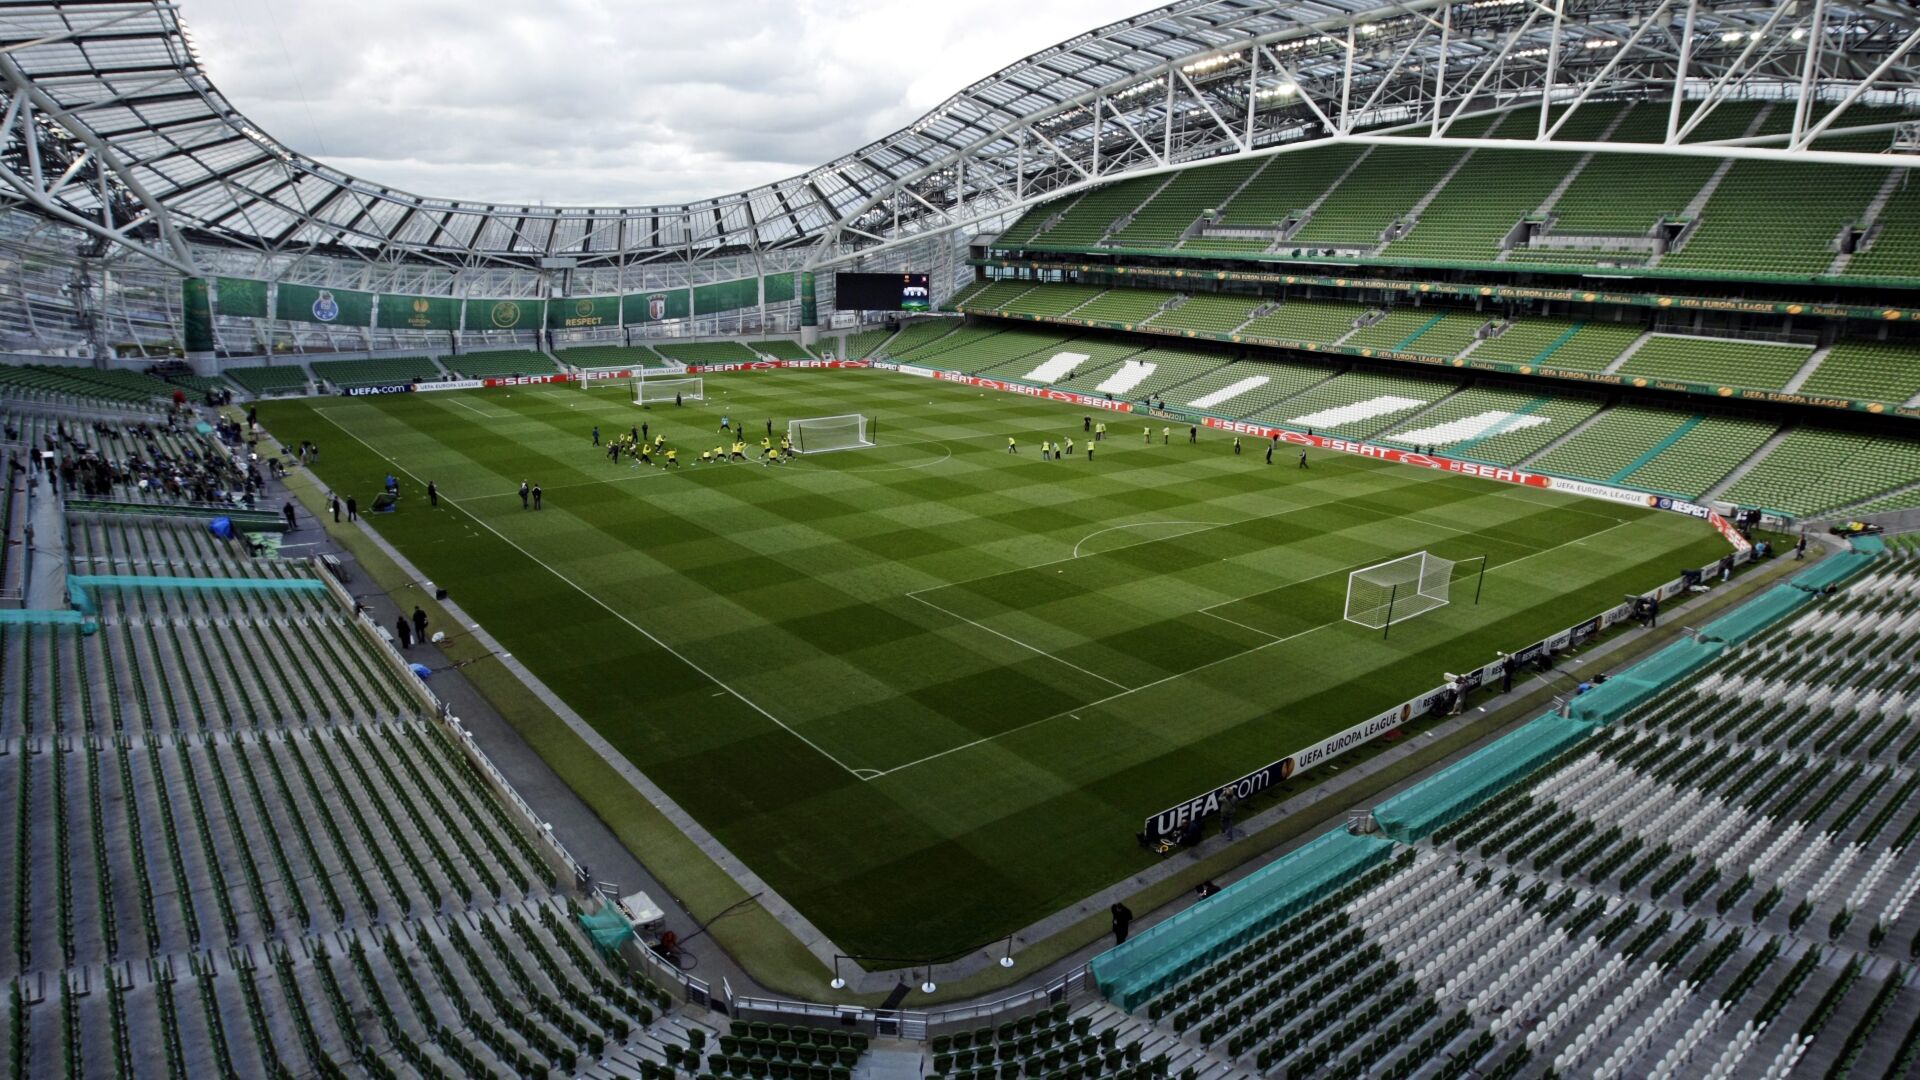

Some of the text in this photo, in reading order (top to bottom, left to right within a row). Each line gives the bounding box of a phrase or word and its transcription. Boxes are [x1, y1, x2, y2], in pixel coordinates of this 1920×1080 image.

[1516, 290, 1542, 298] EUROPA
[1544, 292, 1572, 300] LEAGUE
[1703, 300, 1736, 309] EUROPA
[1739, 302, 1773, 311] LEAGUE
[566, 318, 602, 326] RESPECT
[1393, 353, 1417, 361] EUROPA
[1419, 355, 1443, 363] LEAGUE
[705, 364, 744, 373] SEAT
[874, 362, 898, 371] RESPECT
[505, 376, 554, 386] SEAT
[575, 371, 621, 380] SEAT
[944, 373, 974, 385] SEAT
[1559, 370, 1588, 380] EUROPA
[1590, 374, 1620, 384] LEAGUE
[1010, 384, 1042, 397] SEAT
[1083, 396, 1121, 410] SEAT
[1743, 390, 1849, 408] UEFA EUROPA LEAGUE
[1222, 420, 1272, 437] SEAT
[1332, 440, 1390, 458] SEAT
[1462, 461, 1532, 484] SEAT
[1556, 480, 1642, 502] UEFA EUROPA LEAGUE
[1671, 500, 1710, 518] RESPECT
[1299, 712, 1397, 768] UEFA EUROPA LEAGUE
